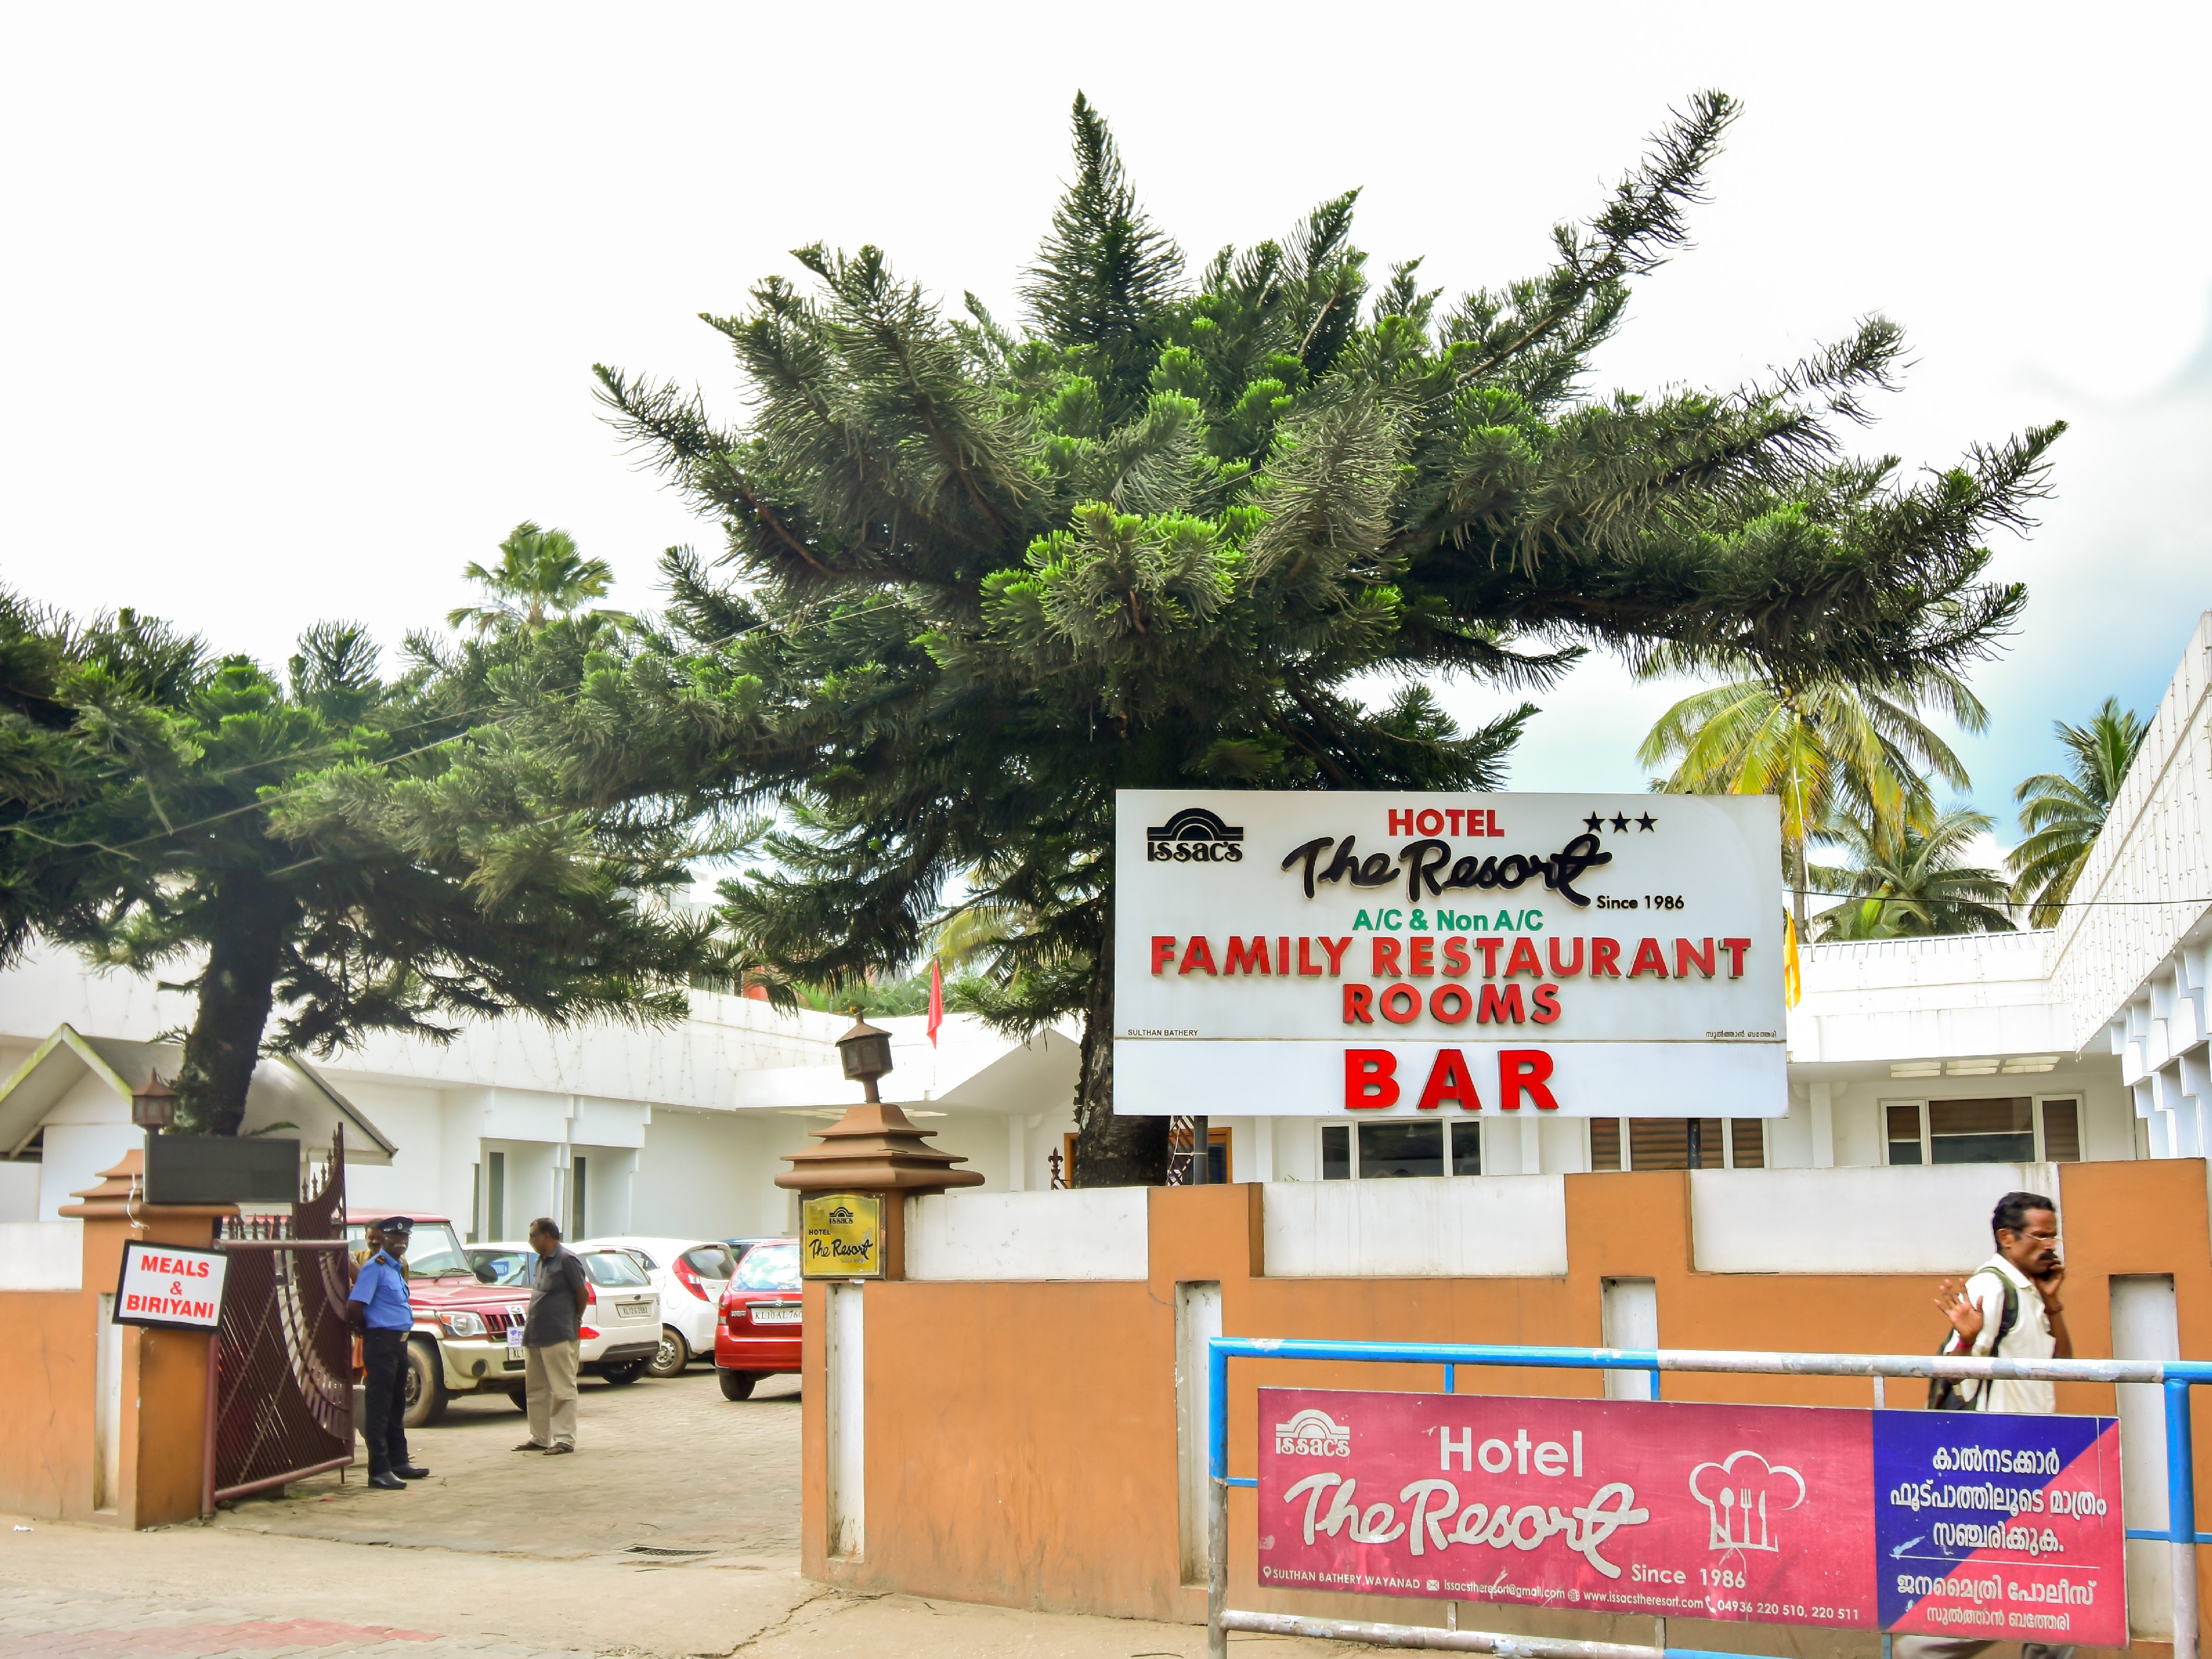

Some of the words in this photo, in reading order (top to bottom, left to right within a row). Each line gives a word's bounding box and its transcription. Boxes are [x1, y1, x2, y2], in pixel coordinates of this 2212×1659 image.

[1388, 809, 1504, 837] HOTEL
[1281, 835, 1401, 900] The
[1398, 833, 1614, 908] Resort
[1597, 895, 1638, 909] Since
[1644, 895, 1685, 909] 1986
[1352, 909, 1403, 931] A/C
[1409, 909, 1429, 931] &
[1437, 909, 1488, 931] Non
[1493, 909, 1544, 931] A/C
[1151, 936, 1353, 976] FAMILY
[1371, 936, 1752, 978] RESTAURANT
[1342, 982, 1561, 1024] ROOMS
[1343, 1049, 1559, 1110] BAR
[809, 1238, 831, 1259] The
[831, 1238, 873, 1260] Resort
[140, 1255, 209, 1278] MEALS
[169, 1281, 183, 1296] &
[126, 1294, 214, 1319] BIRIYANI
[1440, 1426, 1583, 1477] Hotel
[1933, 1445, 2060, 1474] കാൽനടക്കാർ
[2050, 1490, 2107, 1520] മാത്രം
[1283, 1473, 1405, 1545] The
[1400, 1479, 1650, 1579] Resort
[1631, 1563, 1686, 1584] Since
[1700, 1568, 1746, 1589] 1986
[1897, 1574, 2002, 1604] ജനമൈത്രി
[2008, 1578, 2097, 1605] പോലീസ്
[1273, 1569, 1315, 1581] SULTHAN
[1444, 1579, 1565, 1599] issacstheresort@gmail.com
[1583, 1591, 1704, 1609] www.issacstheresort.com
[1717, 1600, 1753, 1613] 04936
[1757, 1603, 1778, 1615] 220
[1782, 1604, 1808, 1618] 510,
[1811, 1606, 1834, 1618] 220
[1838, 1608, 1859, 1620] 511
